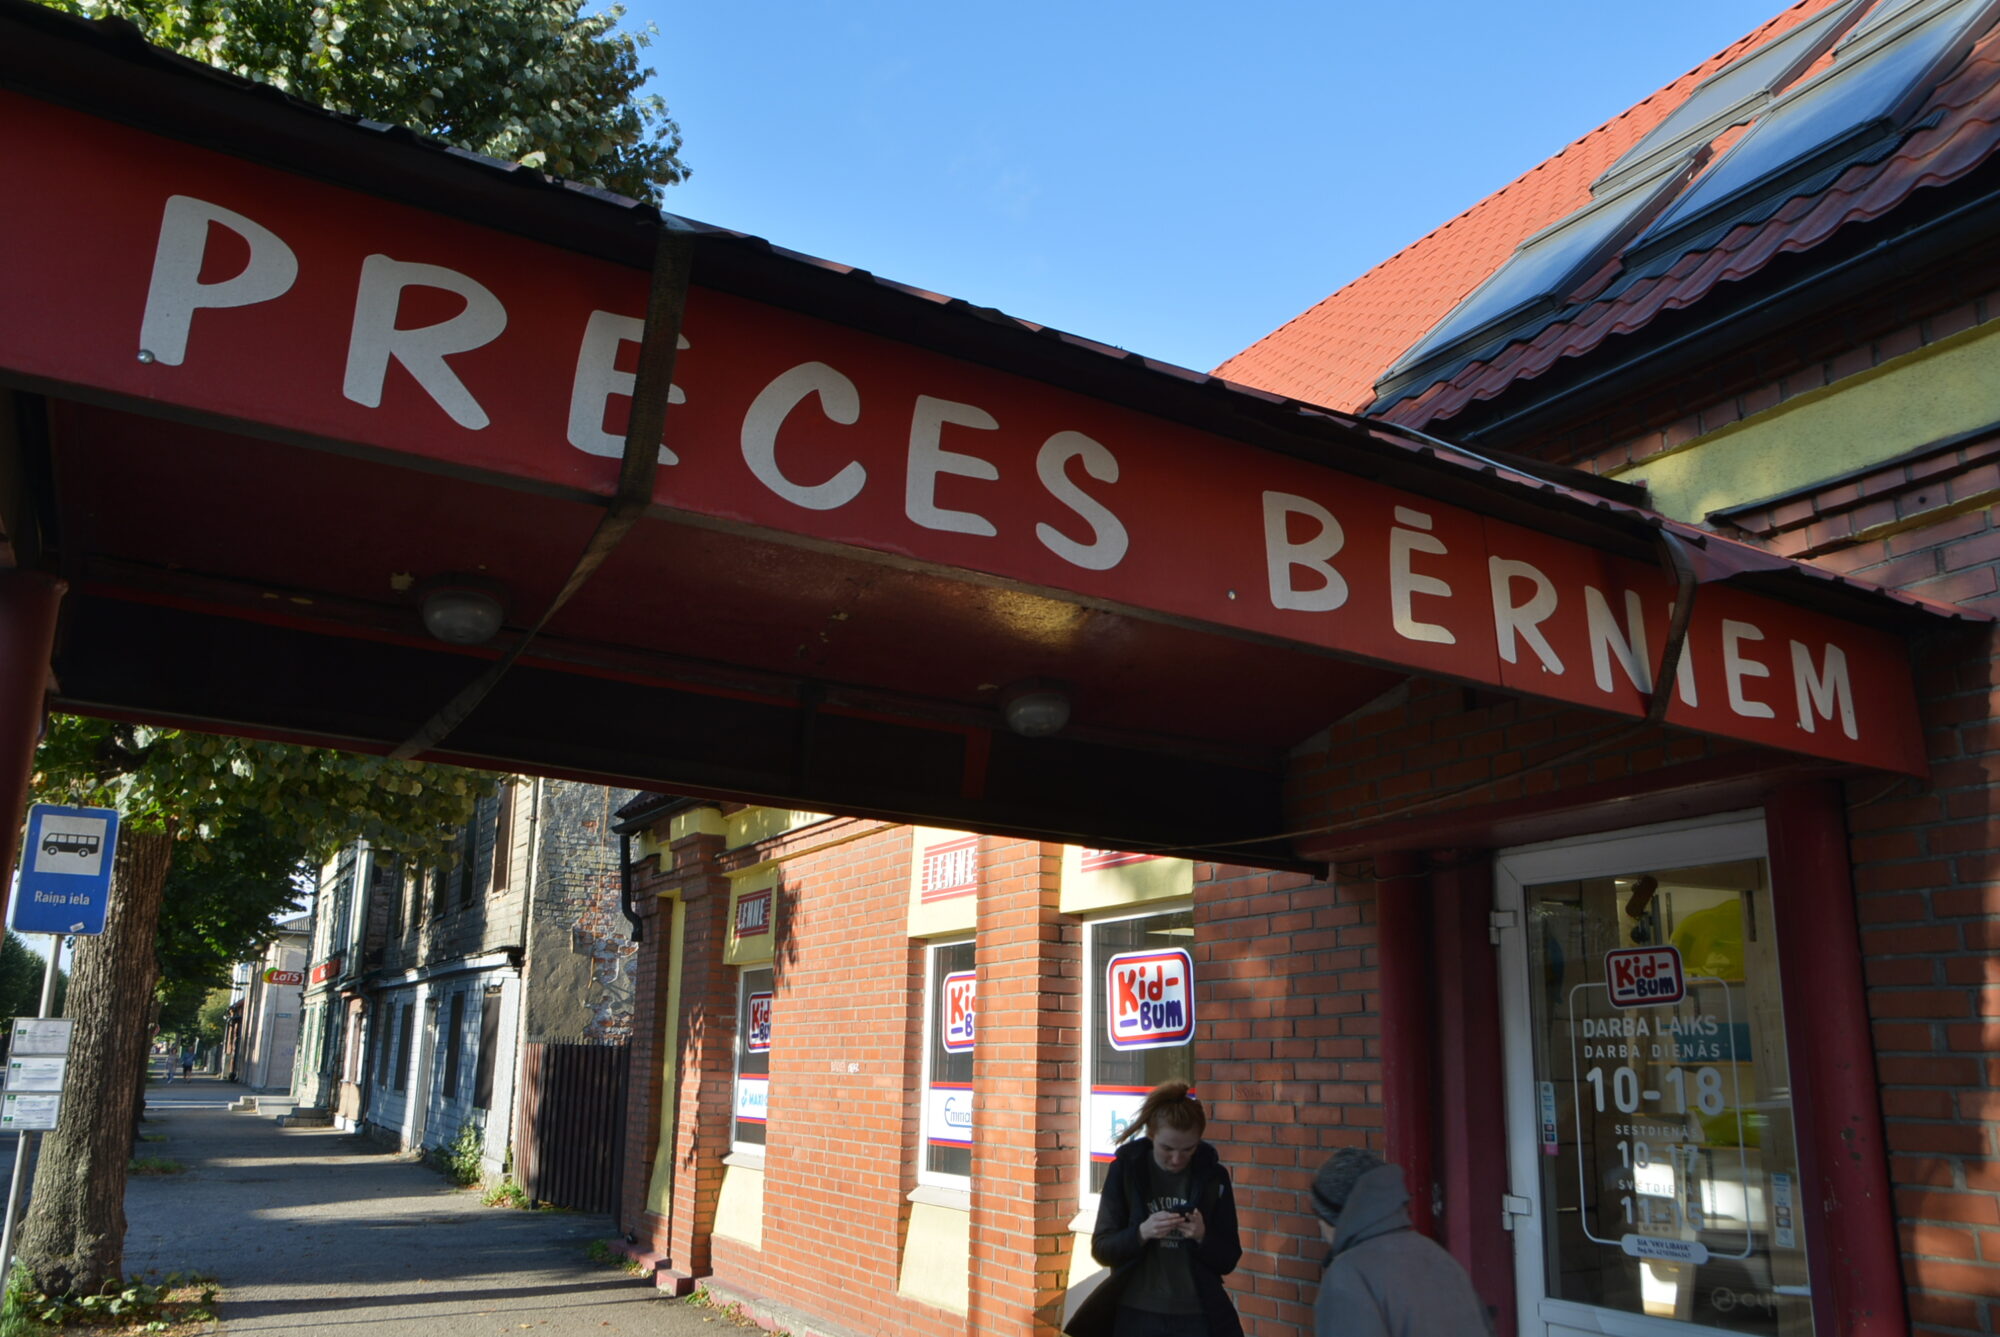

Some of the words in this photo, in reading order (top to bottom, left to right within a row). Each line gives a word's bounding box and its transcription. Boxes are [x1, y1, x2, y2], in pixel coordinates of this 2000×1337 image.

[139, 195, 1128, 571] PRECES
[1262, 490, 1858, 740] BĒRNIEM
[34, 890, 66, 906] Raiņa
[69, 892, 90, 905] iela
[738, 897, 766, 930] LENNE
[1614, 955, 1670, 989] Kid-
[951, 983, 976, 1024] Ki
[1117, 965, 1179, 1016] Kid-
[752, 1000, 772, 1032] Kid
[1582, 1017, 1650, 1038] DARBA
[1655, 1015, 1718, 1037] LAIKS
[1584, 1045, 1641, 1059] DARBA
[1652, 1040, 1720, 1059] DIENĀS
[1586, 1066, 1725, 1116] 10-18
[1614, 1124, 1698, 1138] SESTDIENĀS
[1617, 1141, 1699, 1174] 10-17
[1621, 1196, 1704, 1232] 11-15
